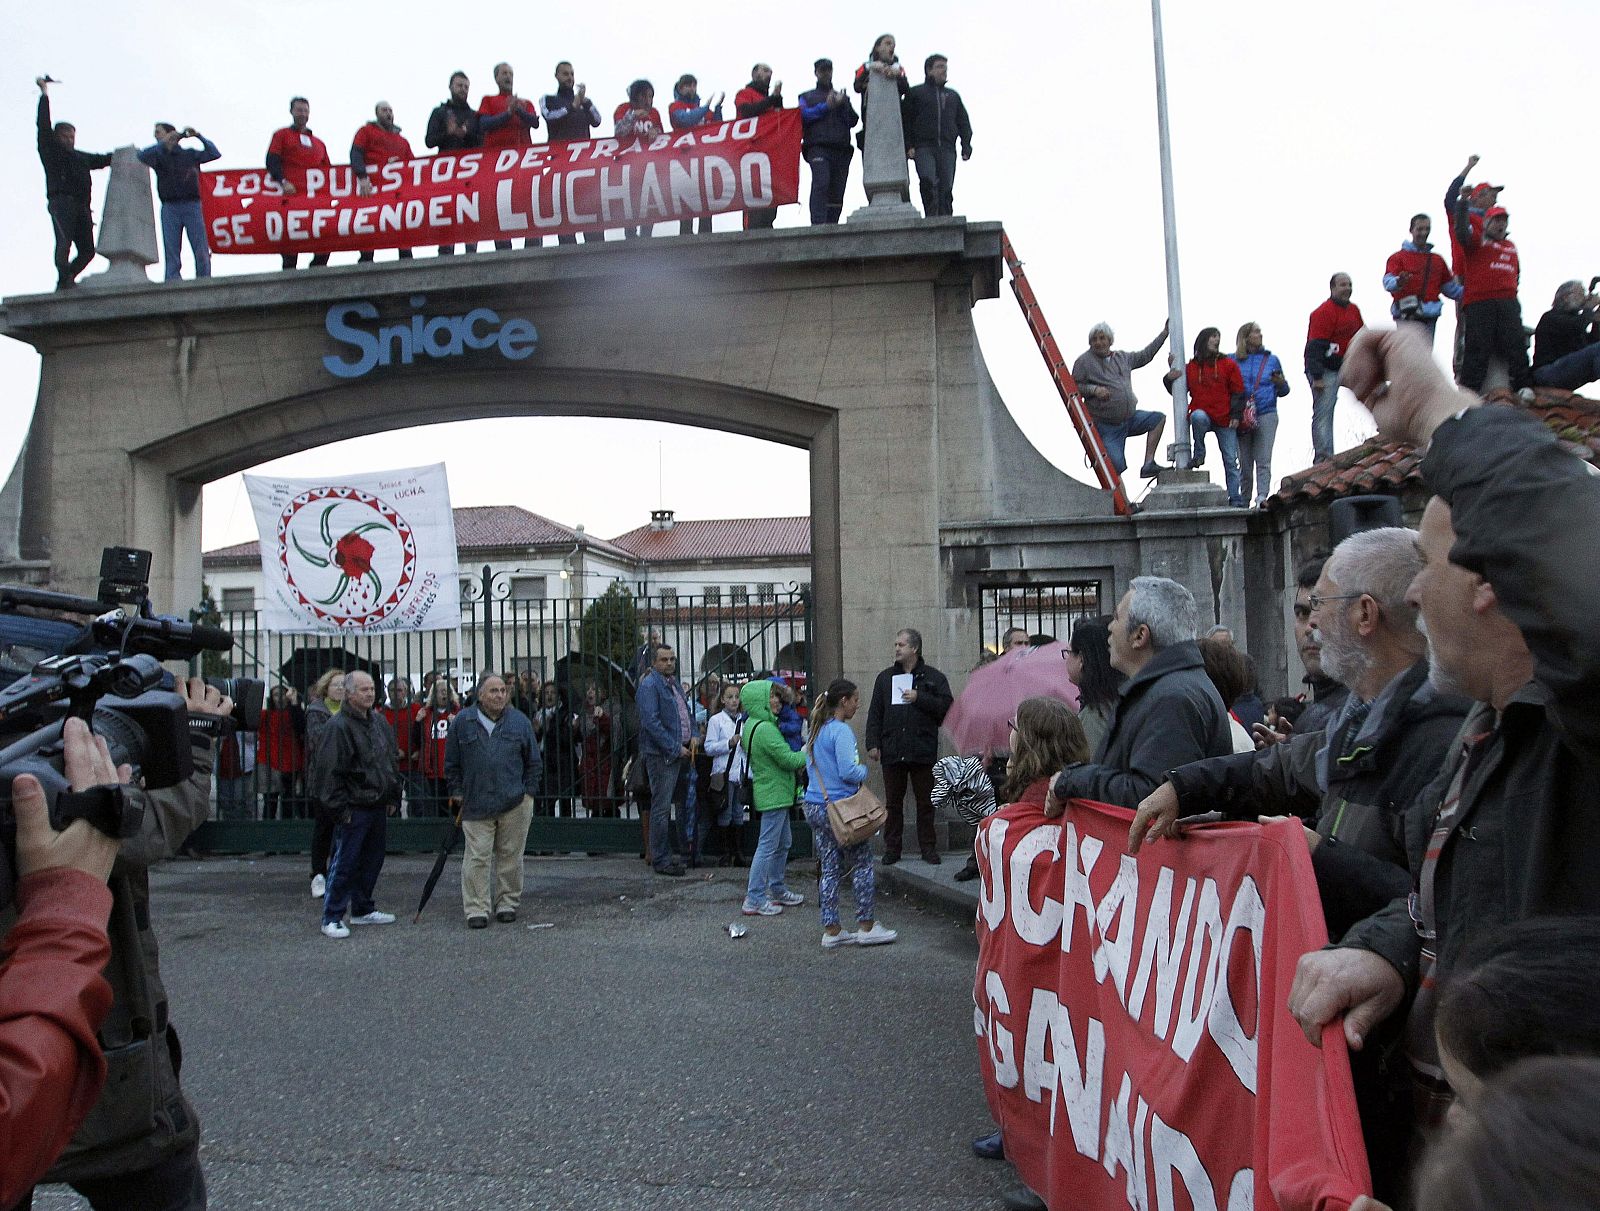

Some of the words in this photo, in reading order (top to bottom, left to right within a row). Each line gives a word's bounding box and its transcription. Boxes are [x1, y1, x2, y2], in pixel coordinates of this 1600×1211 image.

[212, 174, 284, 197] LOS
[306, 153, 483, 198] PUESTOS
[495, 146, 550, 173] DE
[566, 116, 759, 163] TRABAJO
[211, 213, 255, 248] SE
[265, 191, 480, 242] DEFIENDEN
[496, 152, 774, 232] LUCHANDO
[322, 295, 539, 378] Sniace
[394, 485, 426, 501] LUCHA
[188, 719, 214, 728] anon
[974, 817, 1267, 1096] UCHANDO
